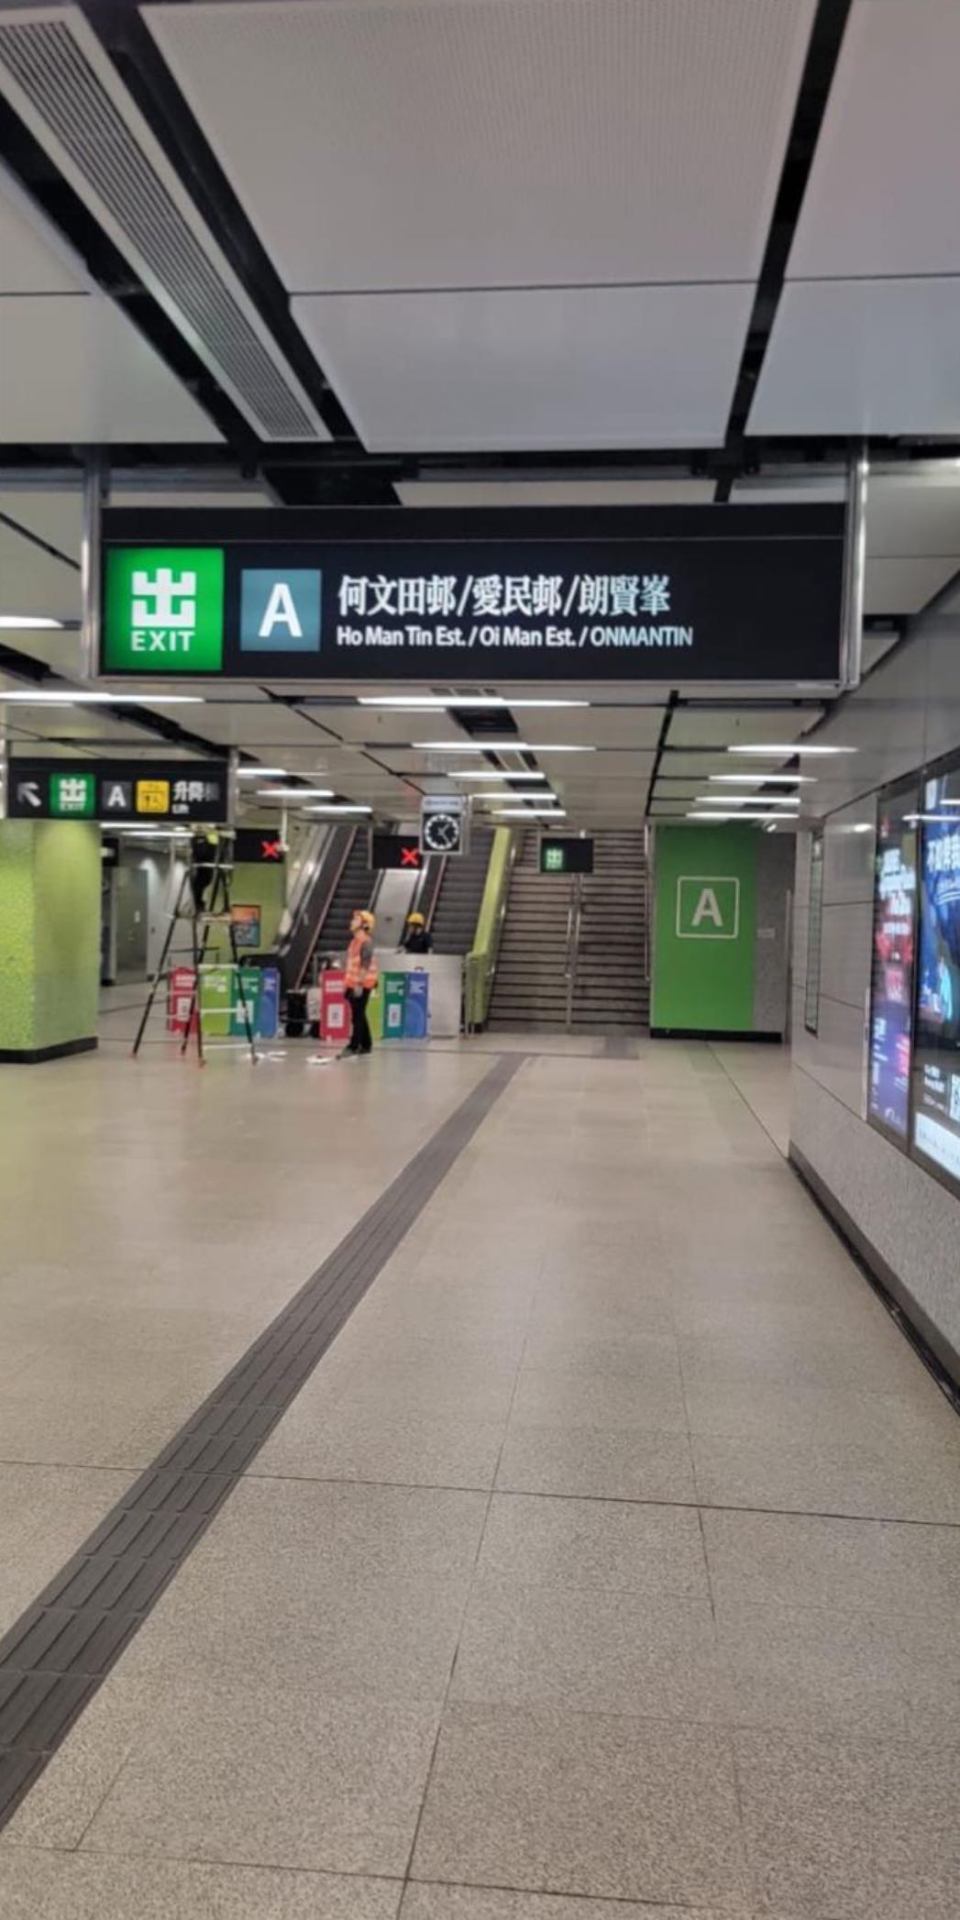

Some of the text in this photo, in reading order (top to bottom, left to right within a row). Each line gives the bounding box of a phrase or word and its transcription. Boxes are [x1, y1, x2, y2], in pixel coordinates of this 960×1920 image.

[257, 582, 303, 638] A
[131, 630, 195, 651] EXIT
[337, 625, 363, 646] Ho
[365, 625, 403, 646] Man
[405, 625, 433, 646] Tin
[435, 625, 466, 646] Est.
[479, 625, 500, 646] Oi
[503, 625, 543, 647] Man
[545, 625, 576, 647] Est.
[590, 625, 694, 647] ONMANTIN
[107, 785, 127, 807] A
[691, 888, 724, 927] A
